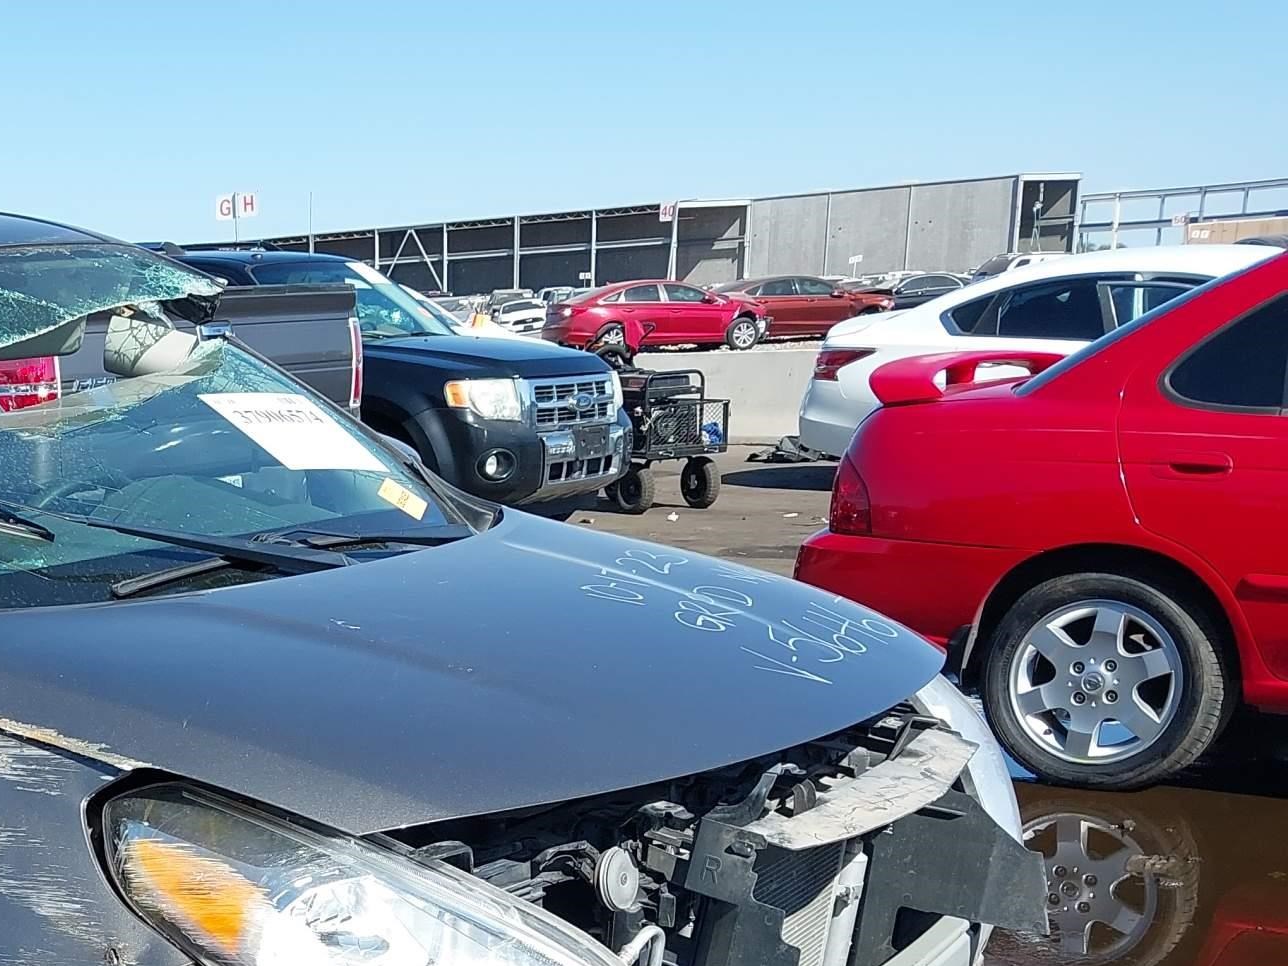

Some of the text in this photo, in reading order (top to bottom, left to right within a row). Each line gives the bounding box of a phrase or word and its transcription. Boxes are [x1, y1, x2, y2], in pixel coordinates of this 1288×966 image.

[219, 199, 231, 216] G
[243, 195, 254, 212] H
[232, 410, 325, 424] 37906574
[702, 854, 722, 884] R
